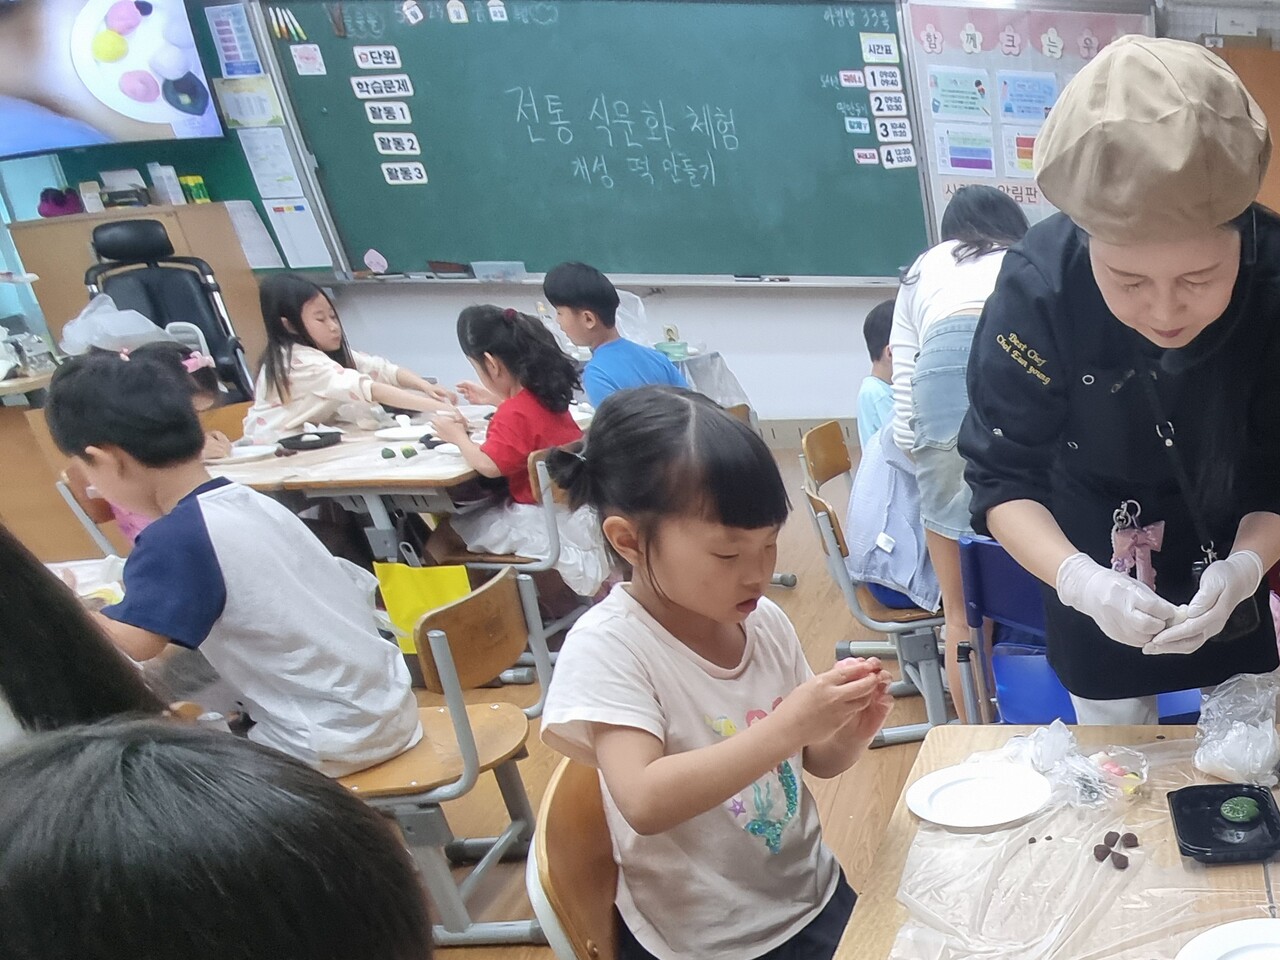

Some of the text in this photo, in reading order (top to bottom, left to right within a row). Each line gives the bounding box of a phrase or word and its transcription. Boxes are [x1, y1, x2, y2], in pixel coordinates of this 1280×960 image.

[370, 50, 397, 65] 단원
[868, 44, 893, 55] 시간표
[356, 79, 410, 94] 학습문제
[870, 71, 877, 87] 1
[874, 96, 884, 112] 2
[505, 86, 739, 150] 전통 식문화 체험
[880, 123, 889, 137] 3
[885, 150, 894, 164] 4
[662, 150, 716, 187] 만들기
[1009, 333, 1047, 367] Best Chef
[1011, 350, 1028, 367] Eun
[1027, 366, 1051, 385] young
